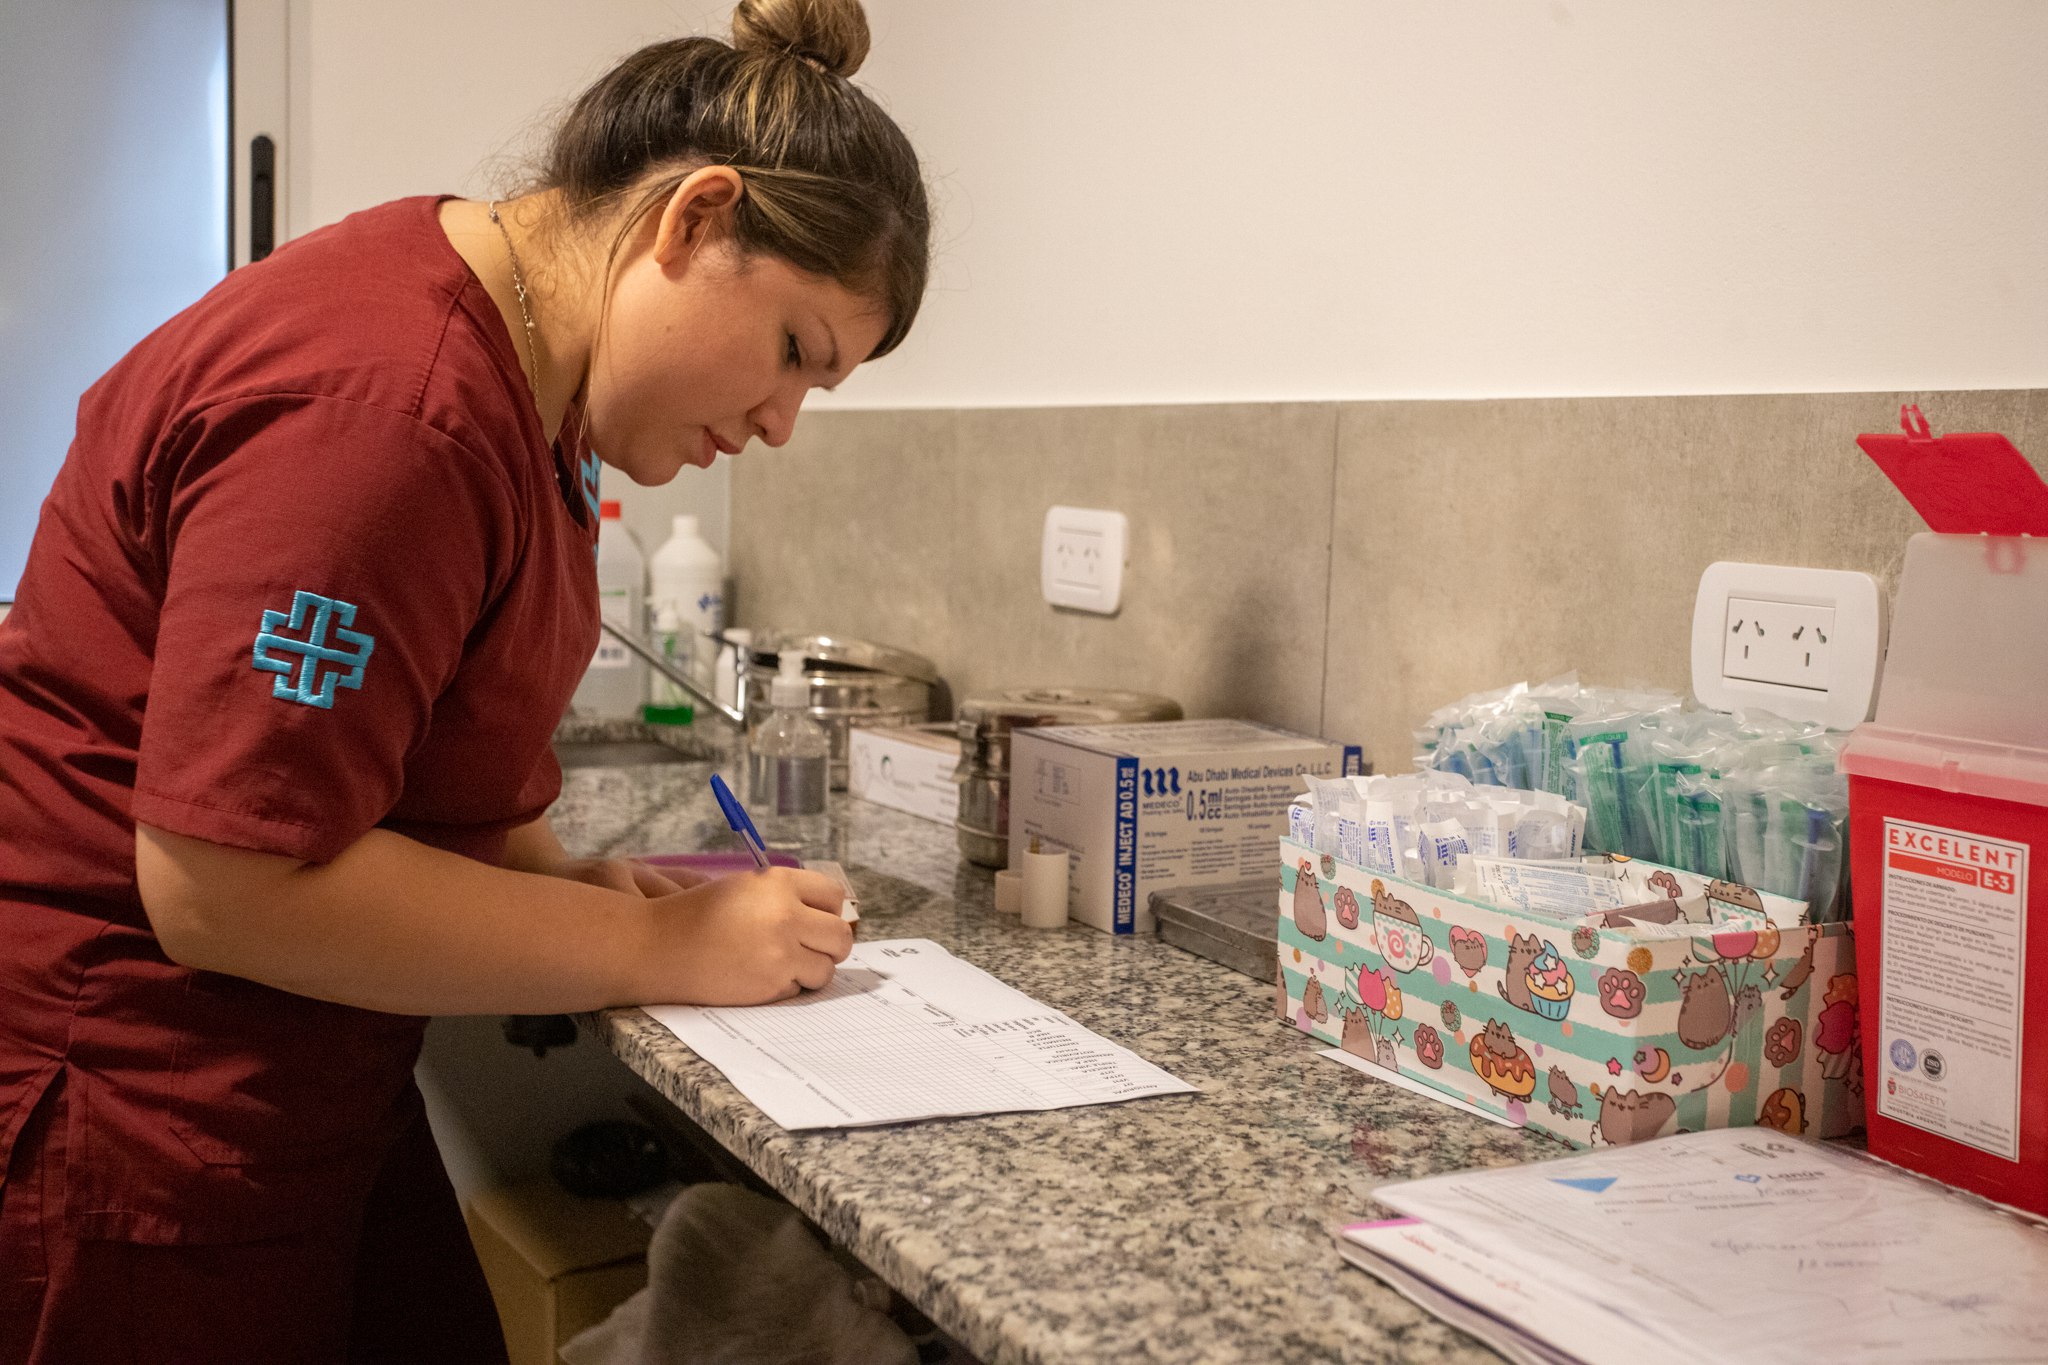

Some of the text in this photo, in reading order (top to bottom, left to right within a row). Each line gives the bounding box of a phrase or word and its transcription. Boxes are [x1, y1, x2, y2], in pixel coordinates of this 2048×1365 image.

[1187, 769, 1202, 783] Abu
[1206, 767, 1230, 782] Dhabi
[1231, 766, 1261, 780] Medical
[1263, 764, 1294, 778] Devices
[1120, 778, 1135, 799] 0.5
[1120, 801, 1134, 819] AD
[1119, 822, 1134, 866] INJECT
[1889, 828, 2016, 869] EXCELENT
[1936, 866, 1974, 882] MODELO
[1983, 871, 2011, 891] E-3
[1117, 873, 1132, 924] MEDECO
[1926, 1059, 1940, 1068] ISO
[1898, 1085, 1947, 1107] BIOSAFETY
